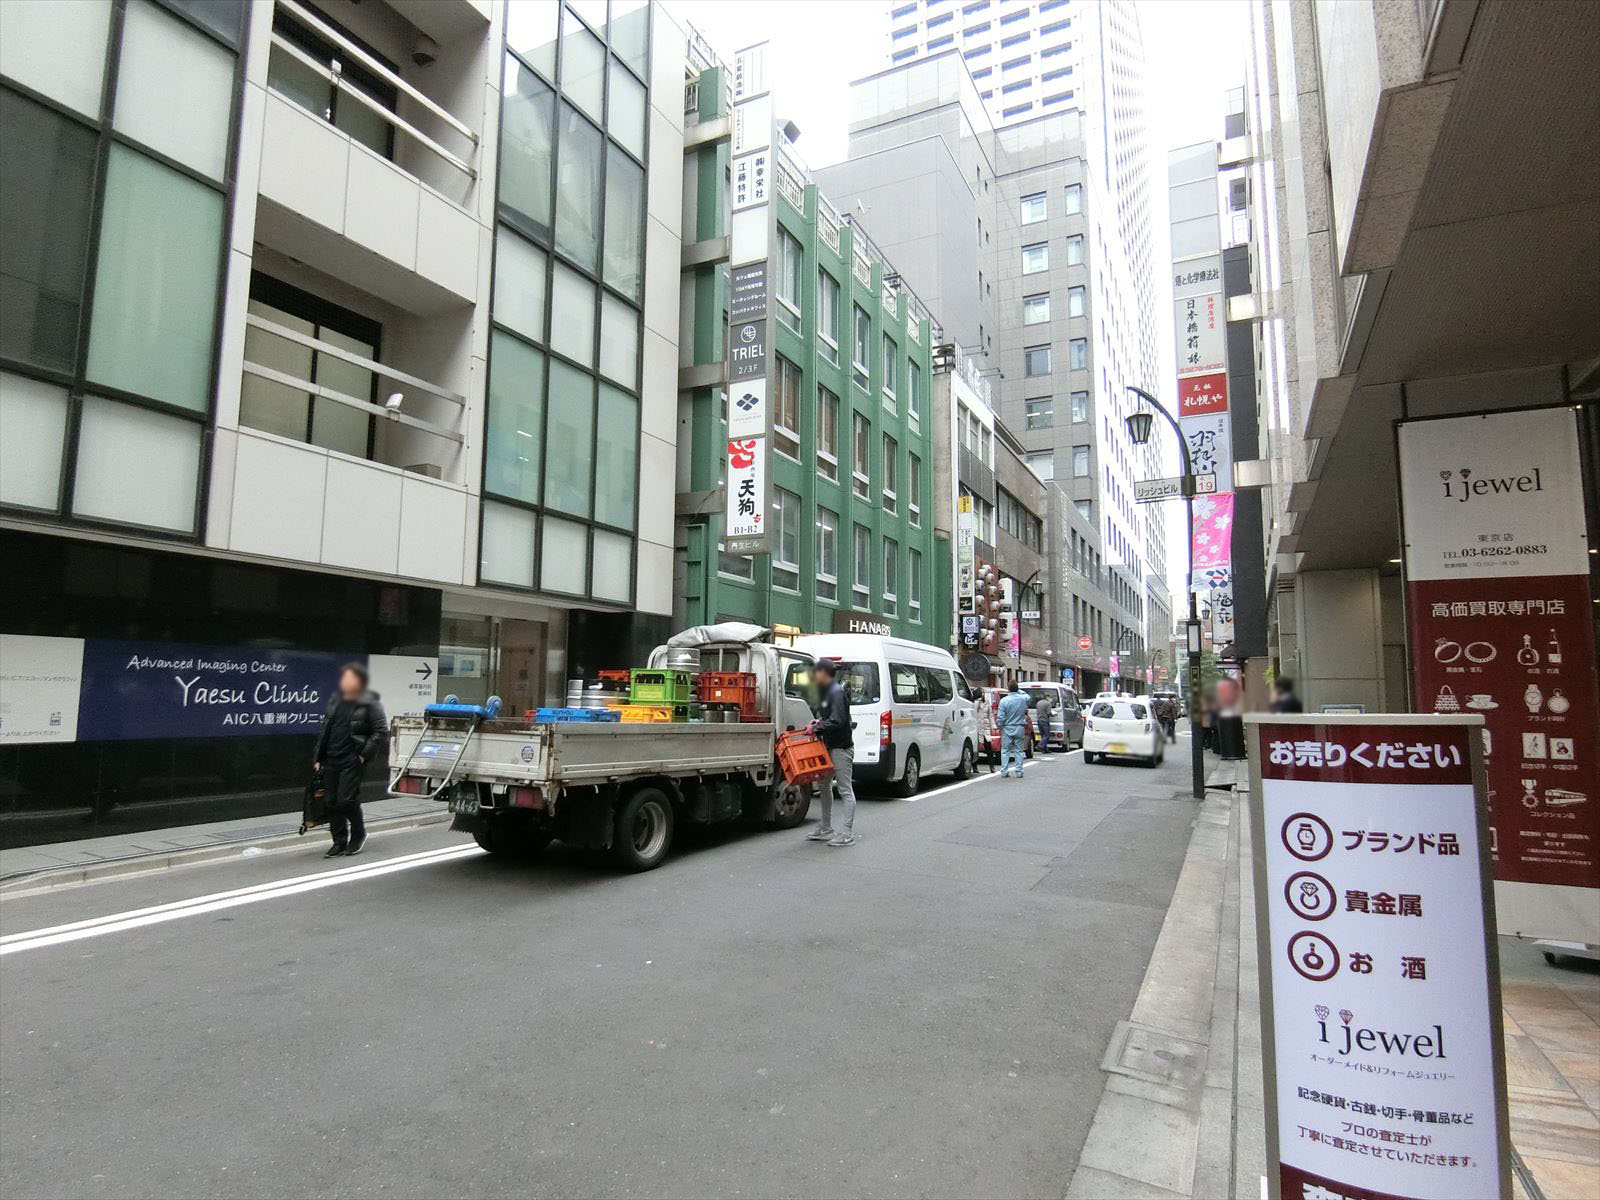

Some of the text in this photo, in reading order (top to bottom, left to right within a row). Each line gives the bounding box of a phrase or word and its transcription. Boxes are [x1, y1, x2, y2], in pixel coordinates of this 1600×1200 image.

[732, 343, 765, 361] TRIEL
[738, 479, 755, 516] 天狗
[1137, 484, 1178, 497] リッシュビル
[1199, 481, 1213, 491] 19
[1459, 468, 1544, 502] jewel
[1477, 533, 1514, 542] 東京店
[1431, 600, 1565, 618] 高価買取専門店
[126, 655, 288, 673] Advanced Imaging Center
[174, 675, 320, 708] Yaesu Clinic
[1268, 740, 1462, 769] お売りください
[1341, 830, 1460, 856] ブランド品
[1344, 890, 1423, 917] 貴金属
[1337, 1009, 1448, 1059] jewel
[1297, 1125, 1478, 1168] 丁寧に査定させていただきます。
[1341, 1121, 1433, 1146] プロの査定士が
